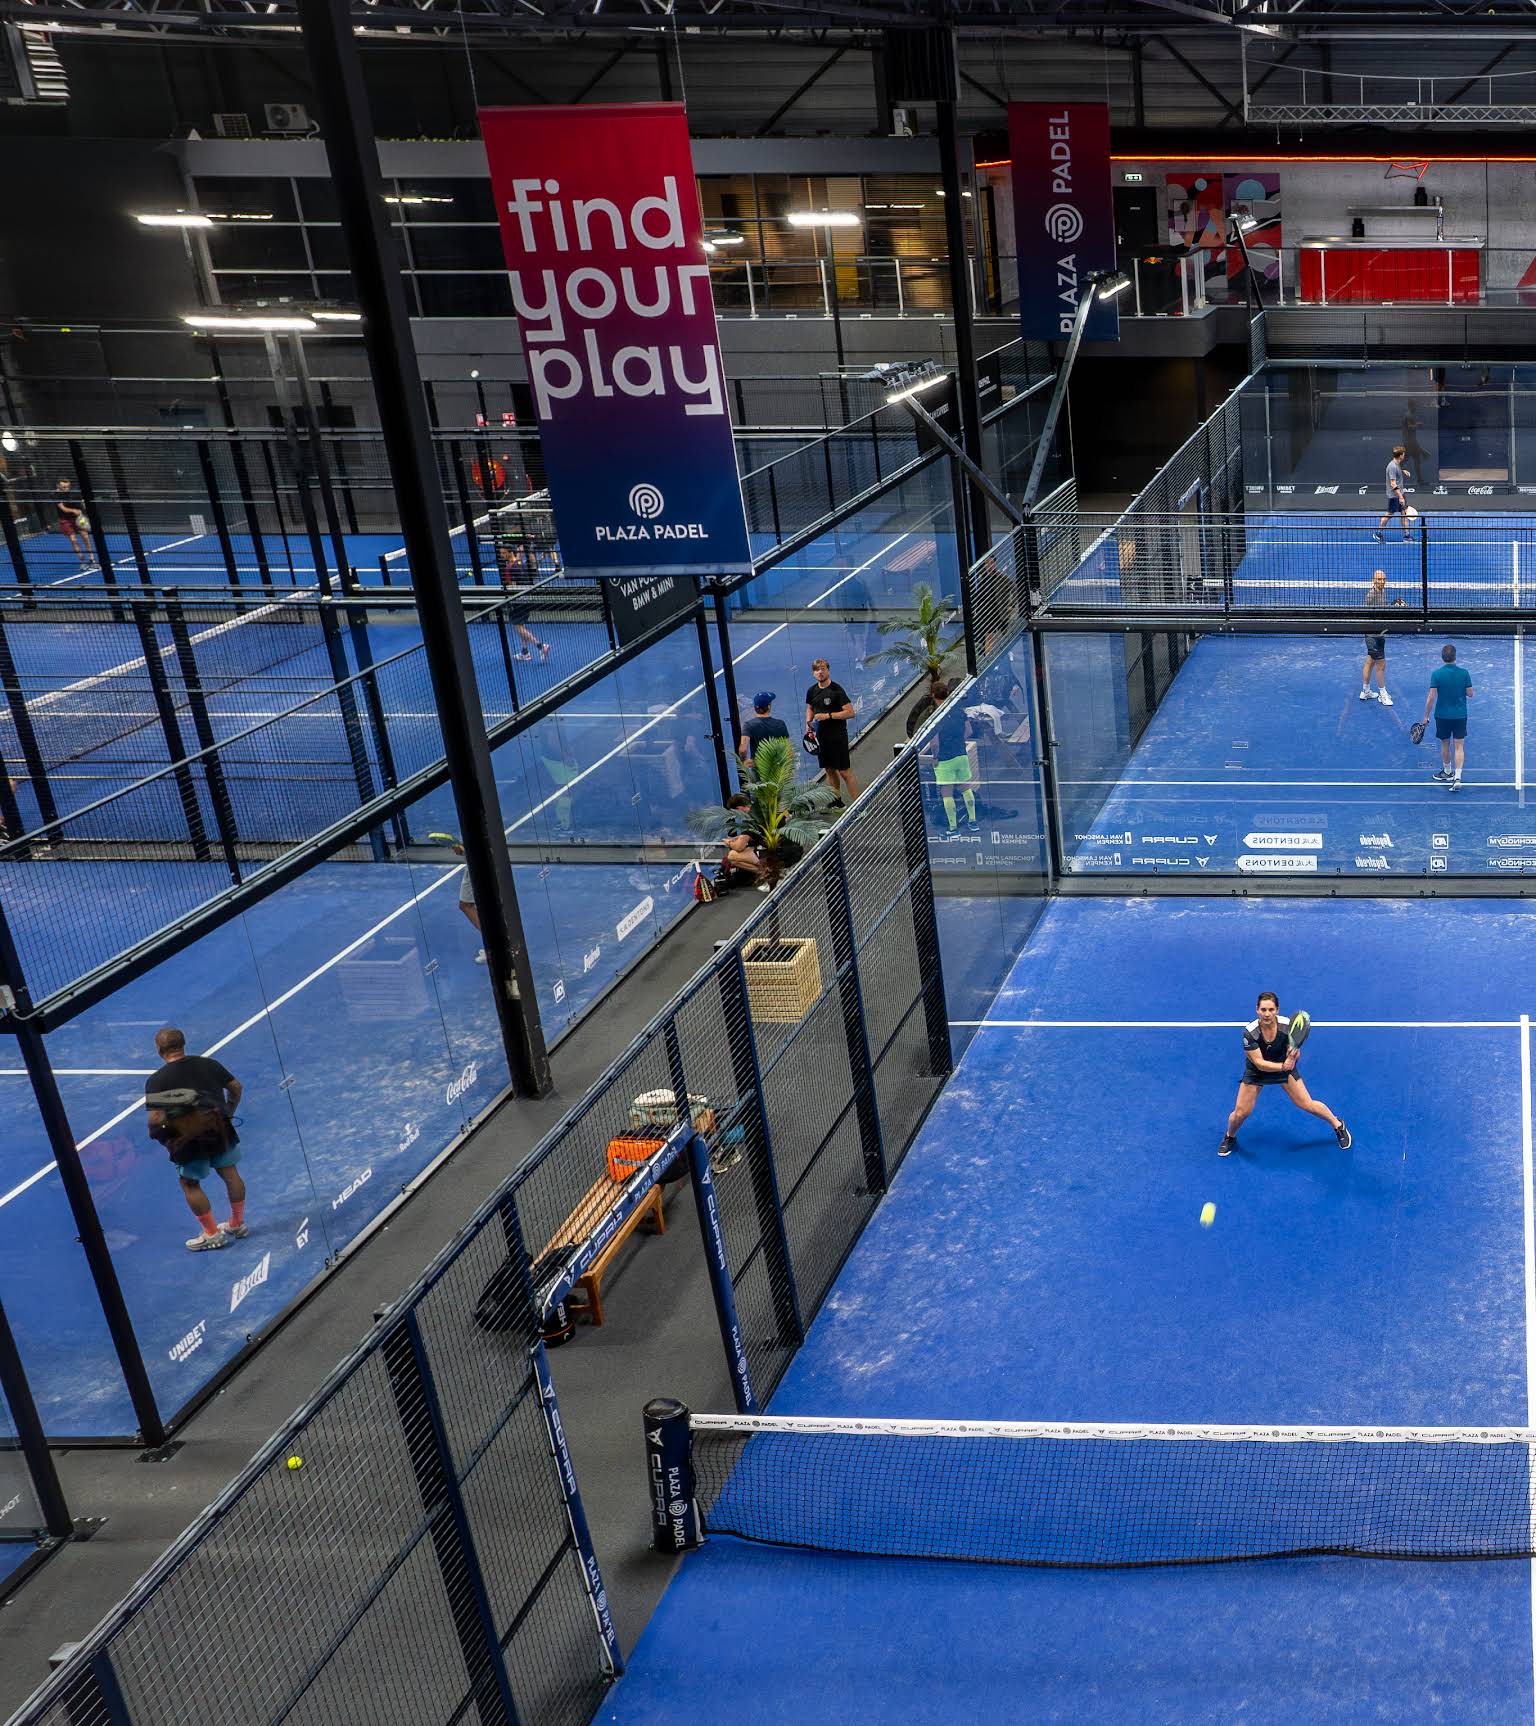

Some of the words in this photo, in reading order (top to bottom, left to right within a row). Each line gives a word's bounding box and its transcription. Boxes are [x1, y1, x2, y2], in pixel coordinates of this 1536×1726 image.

[1049, 111, 1073, 193] PADEL
[508, 176, 685, 252] find
[508, 264, 709, 342] your
[1057, 253, 1079, 333] PLAZA
[528, 328, 724, 420] play
[596, 526, 650, 541] PLAZA
[655, 524, 709, 539] PADEL
[620, 578, 639, 597] VAN
[633, 589, 651, 610] BMW
[651, 587, 657, 599] &
[657, 577, 674, 595] MINI
[627, 903, 650, 929] DENTONS
[332, 1167, 372, 1210] HEAD
[634, 1181, 652, 1203] PLAZA
[296, 1229, 309, 1249] EY
[580, 1211, 623, 1269] CUPRA
[707, 1194, 725, 1270] CUPRA
[168, 1319, 207, 1360] UNIBET
[731, 1326, 742, 1357] PLAZA
[741, 1373, 751, 1406] PADEL
[552, 1408, 577, 1495] CUPRA
[652, 1453, 667, 1527] CUPRA
[668, 1467, 680, 1498] PLAZA
[673, 1518, 685, 1548] PADEL
[587, 1556, 600, 1593] PLAZA
